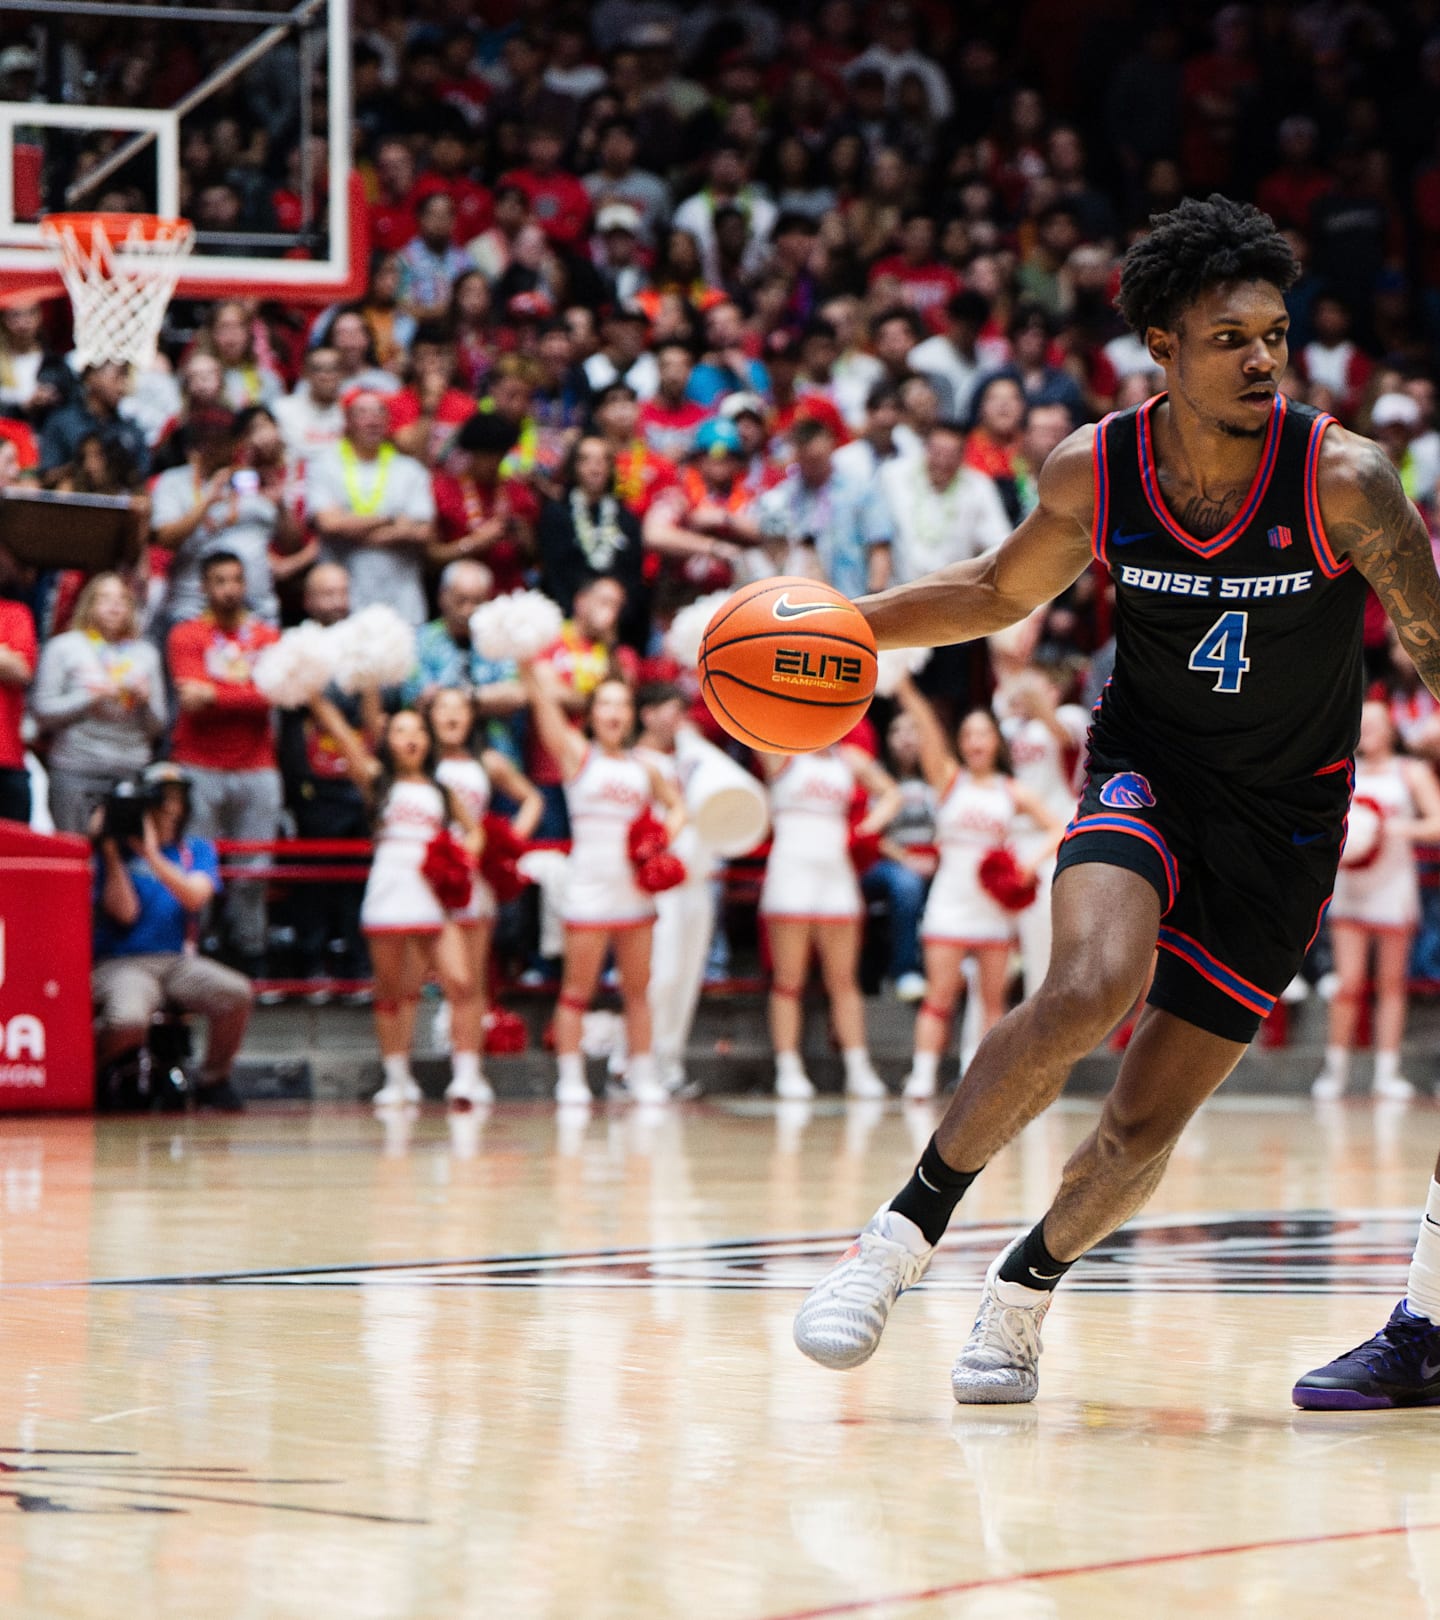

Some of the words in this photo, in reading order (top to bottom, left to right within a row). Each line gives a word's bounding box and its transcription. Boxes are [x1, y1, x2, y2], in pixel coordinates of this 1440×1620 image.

[1120, 564, 1212, 597] BOISE
[1218, 570, 1313, 598] STATE
[773, 648, 862, 684] ELITE
[1188, 611, 1250, 693] 4
